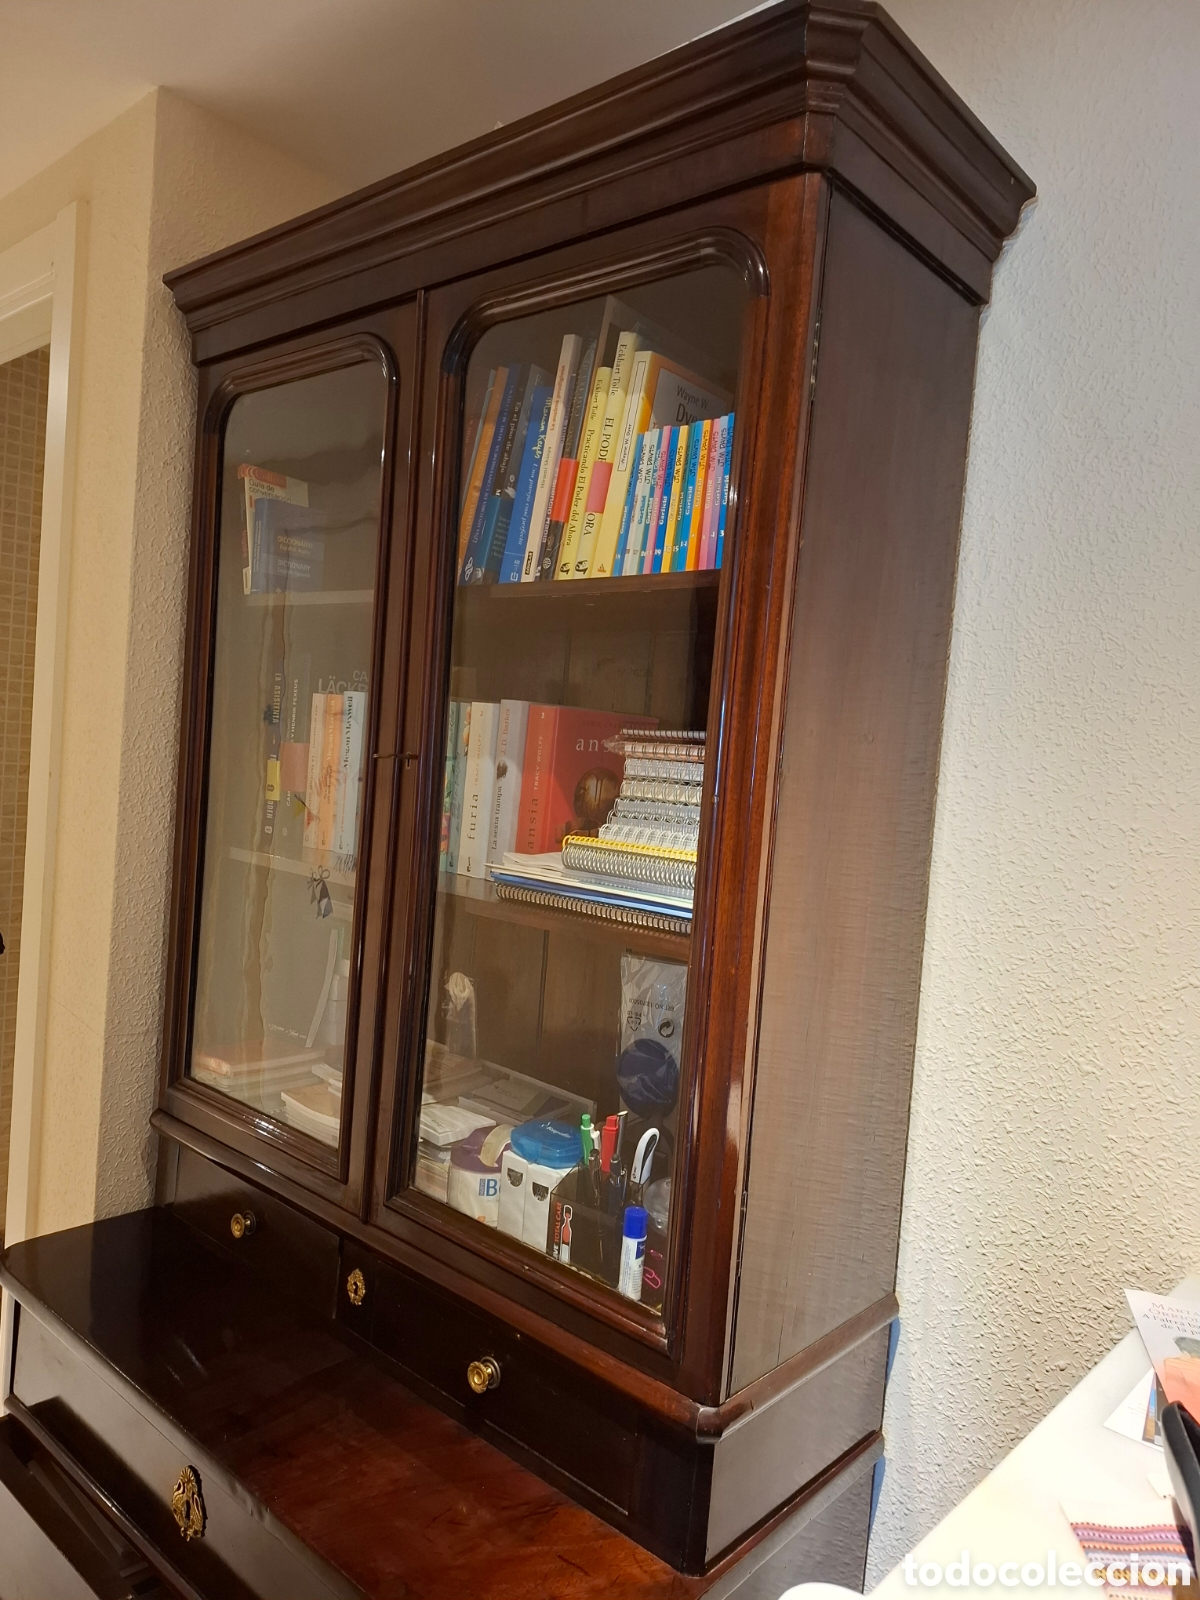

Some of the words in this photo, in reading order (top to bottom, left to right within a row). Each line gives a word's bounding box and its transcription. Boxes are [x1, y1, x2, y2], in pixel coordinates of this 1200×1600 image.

[615, 344, 627, 374] Eckhart
[593, 379, 603, 403] Eckhart
[610, 376, 620, 396] Tolle
[677, 385, 700, 405] Wayne
[513, 413, 518, 422] el
[514, 401, 521, 412] En
[590, 404, 598, 421] Tolle
[604, 417, 615, 428] EL
[505, 441, 512, 451] de
[532, 434, 546, 459] Keyes
[580, 429, 595, 474] Practicando
[500, 452, 509, 473] abajo
[579, 475, 586, 484] El
[573, 485, 584, 509] Poder
[685, 486, 693, 515] Garfield
[570, 509, 579, 521] del
[659, 496, 668, 525] Garfield
[566, 523, 577, 546] Ahora
[272, 685, 282, 723] ASISTENTA
[492, 839, 498, 850] La
[495, 785, 503, 814] trampa
[503, 708, 511, 737] Barker
[467, 794, 479, 841] furia
[527, 797, 539, 850] ansia
